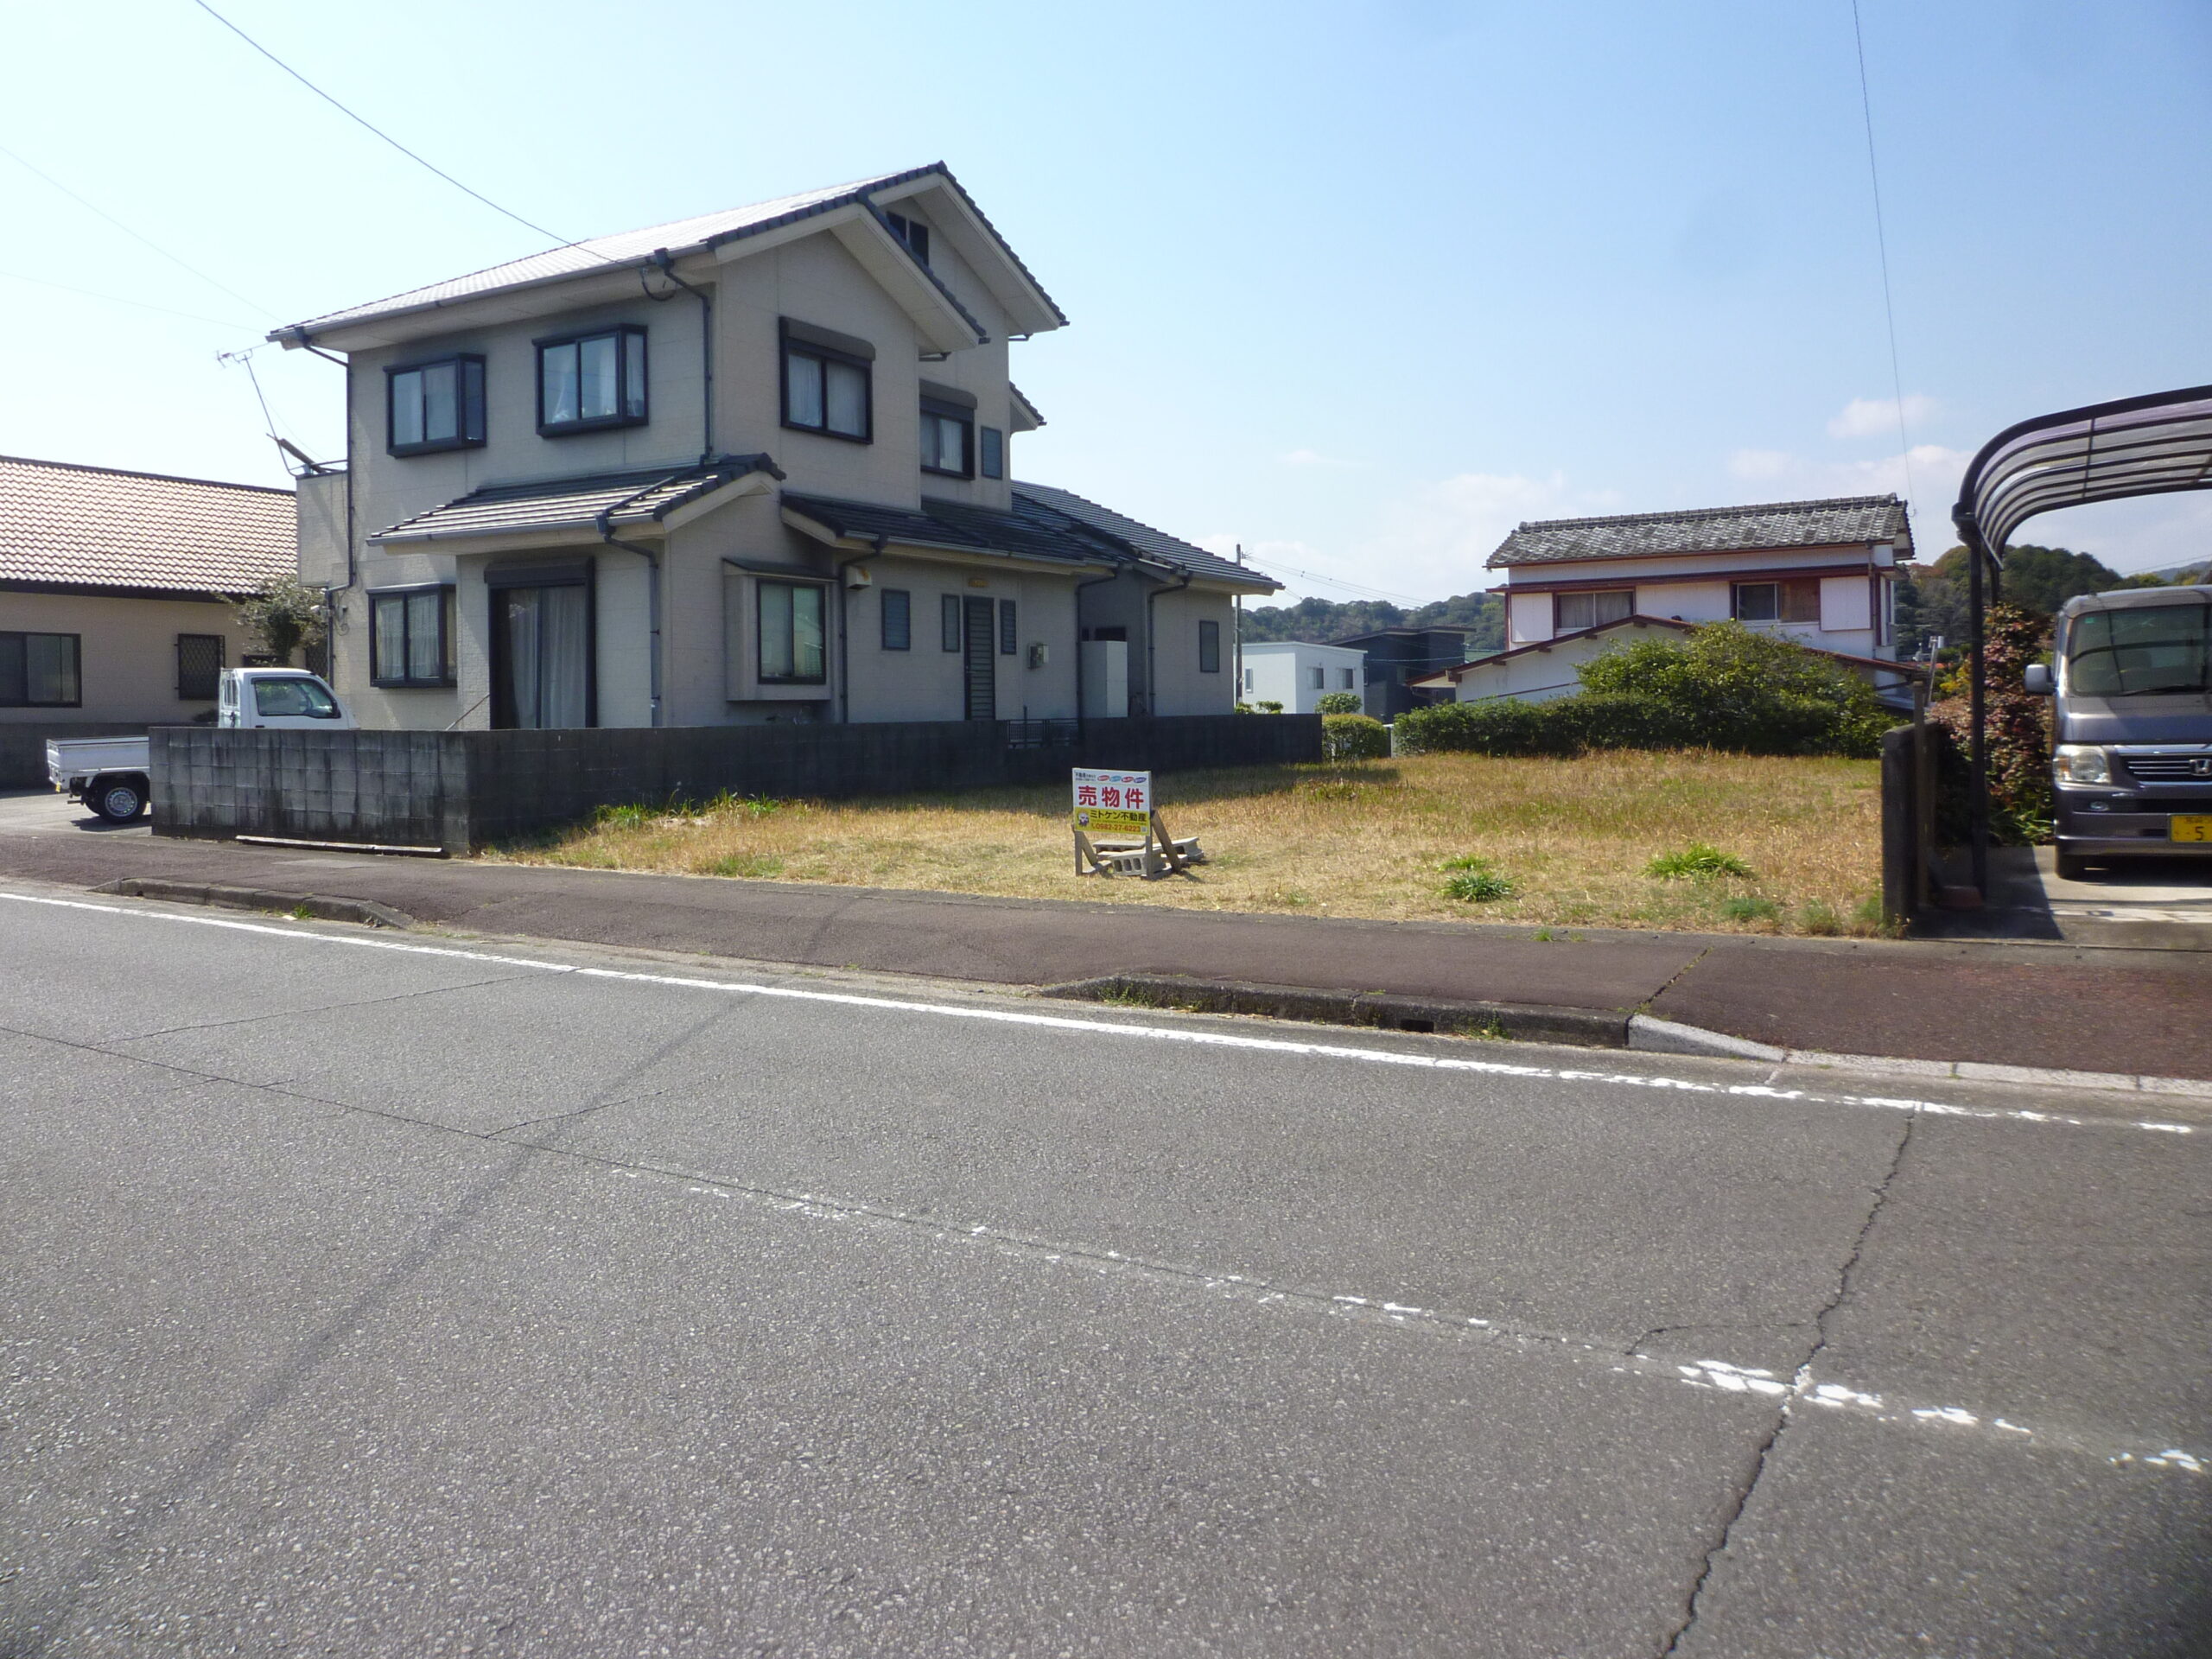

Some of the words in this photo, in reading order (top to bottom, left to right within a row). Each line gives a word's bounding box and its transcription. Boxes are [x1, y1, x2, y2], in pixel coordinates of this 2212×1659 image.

[1078, 785, 1144, 810] 売物件
[1090, 810, 1147, 822] ミトケン不動産
[1096, 823, 1141, 832] 0982-27-6223
